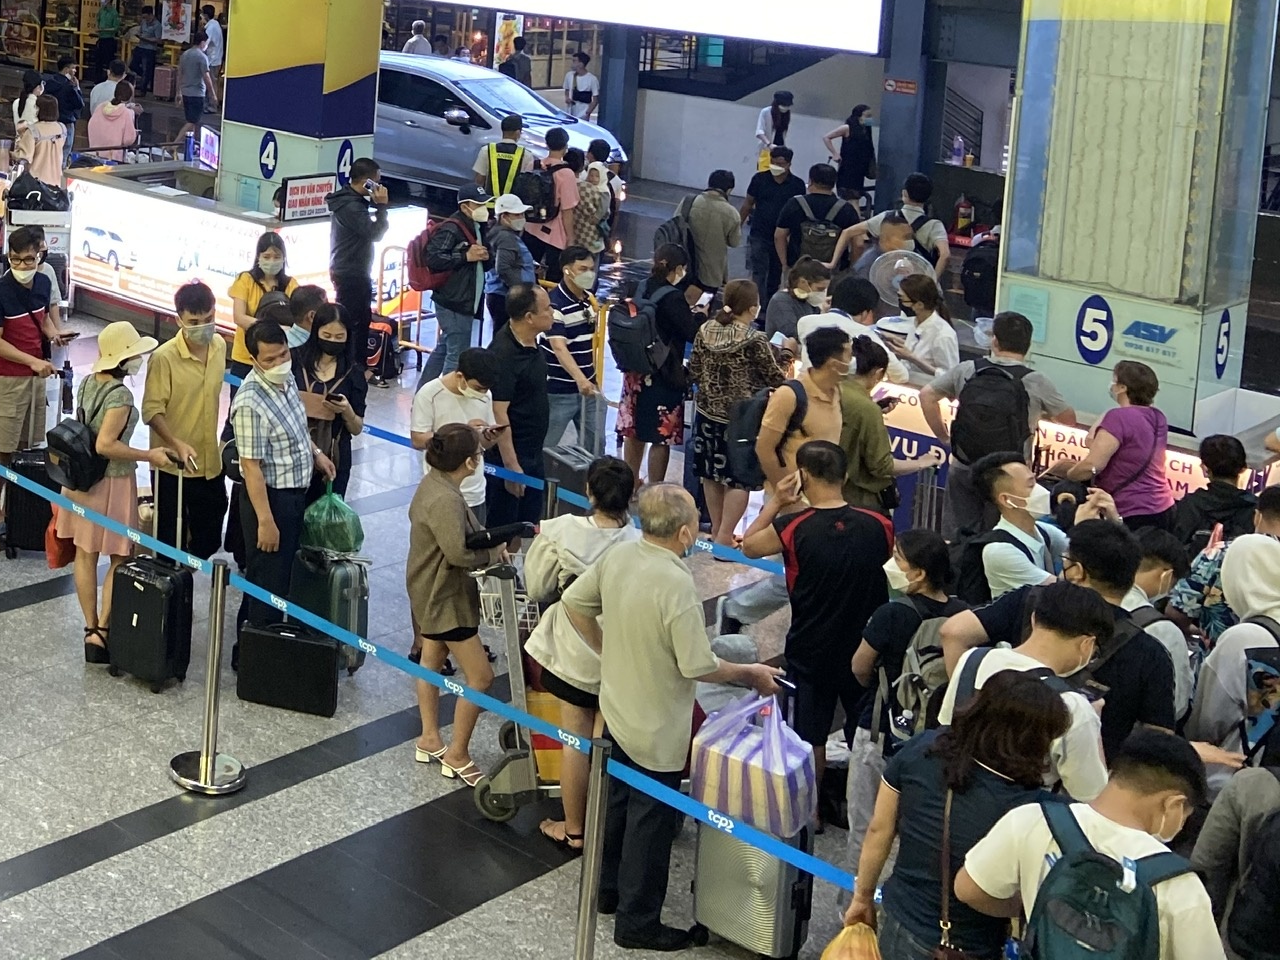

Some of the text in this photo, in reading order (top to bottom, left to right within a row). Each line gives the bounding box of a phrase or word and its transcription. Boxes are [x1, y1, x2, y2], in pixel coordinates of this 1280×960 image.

[261, 142, 275, 170] 4
[339, 149, 351, 178] 4
[1080, 308, 1108, 351] 5
[1123, 321, 1178, 343] ASV
[1217, 322, 1228, 365] 5
